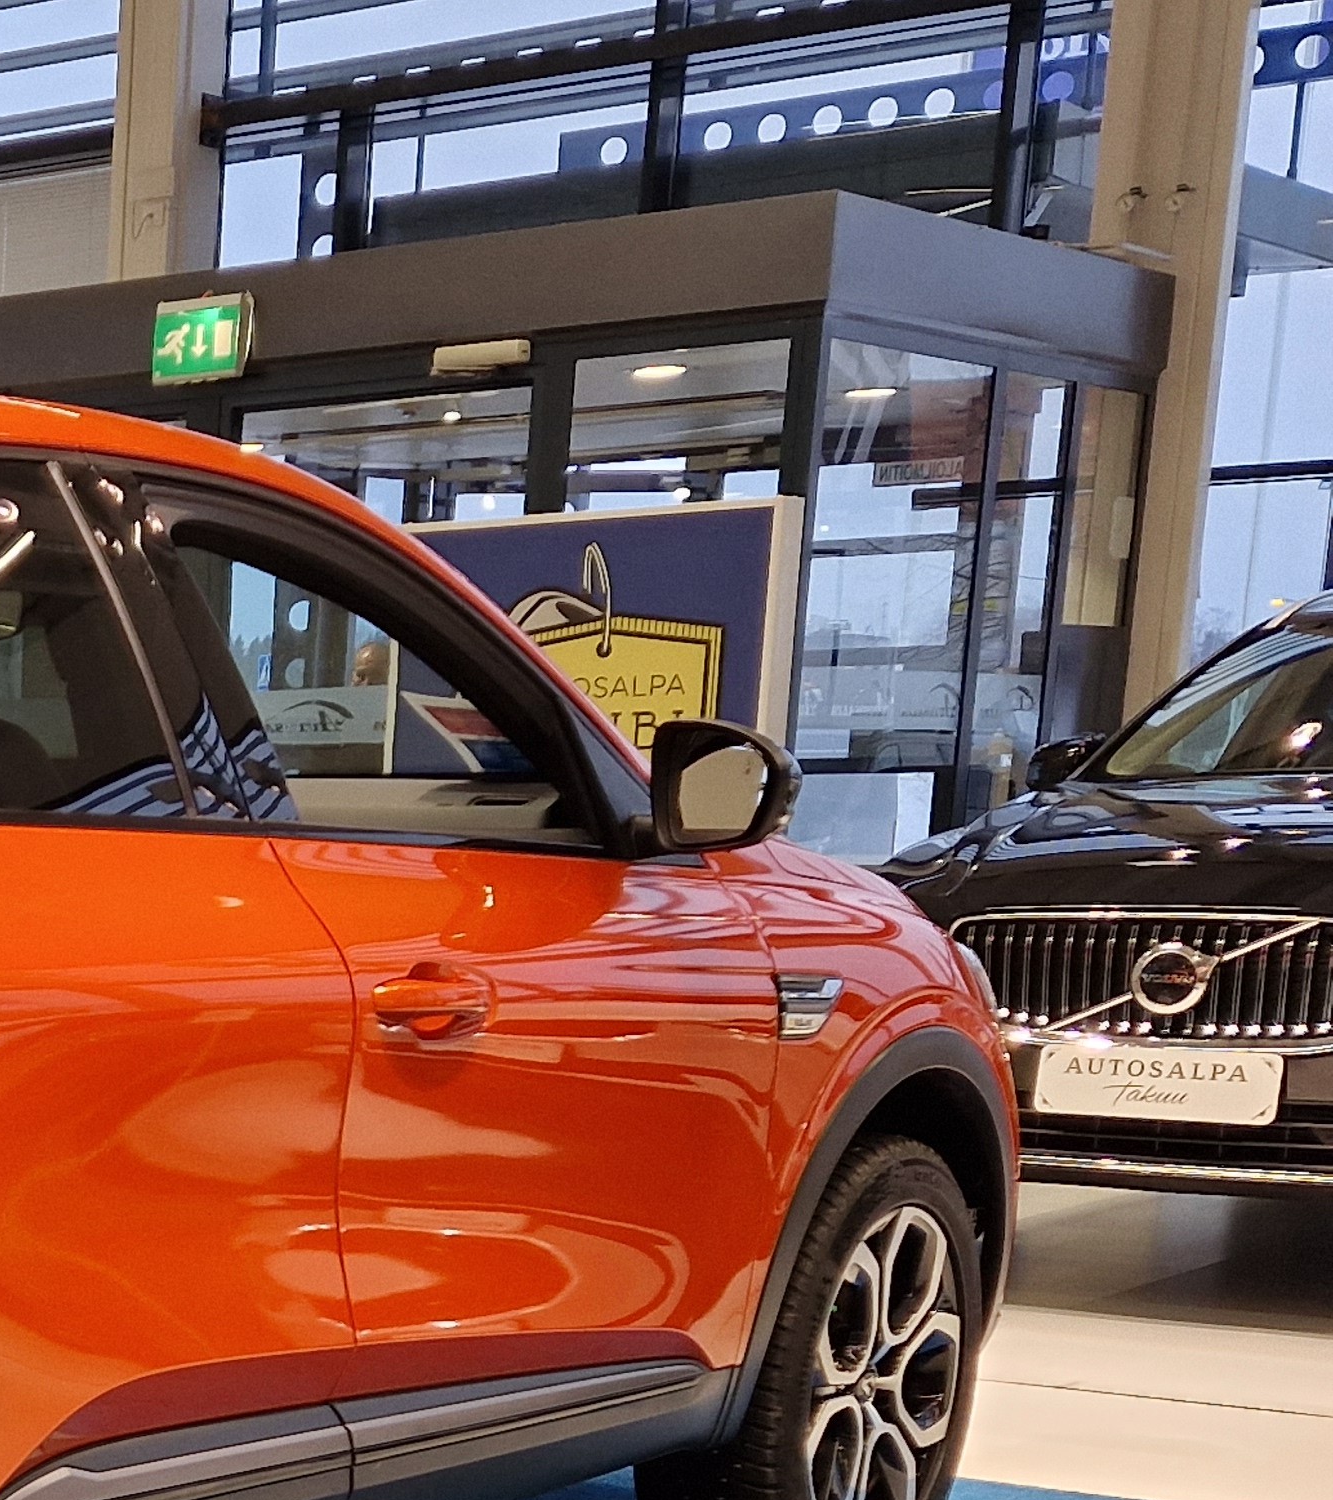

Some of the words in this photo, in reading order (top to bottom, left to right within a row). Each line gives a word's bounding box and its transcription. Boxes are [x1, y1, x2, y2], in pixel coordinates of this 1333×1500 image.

[574, 674, 686, 699] OSALPA
[1064, 1056, 1249, 1083] AUTOSALPA
[1102, 1080, 1190, 1107] Takuu
